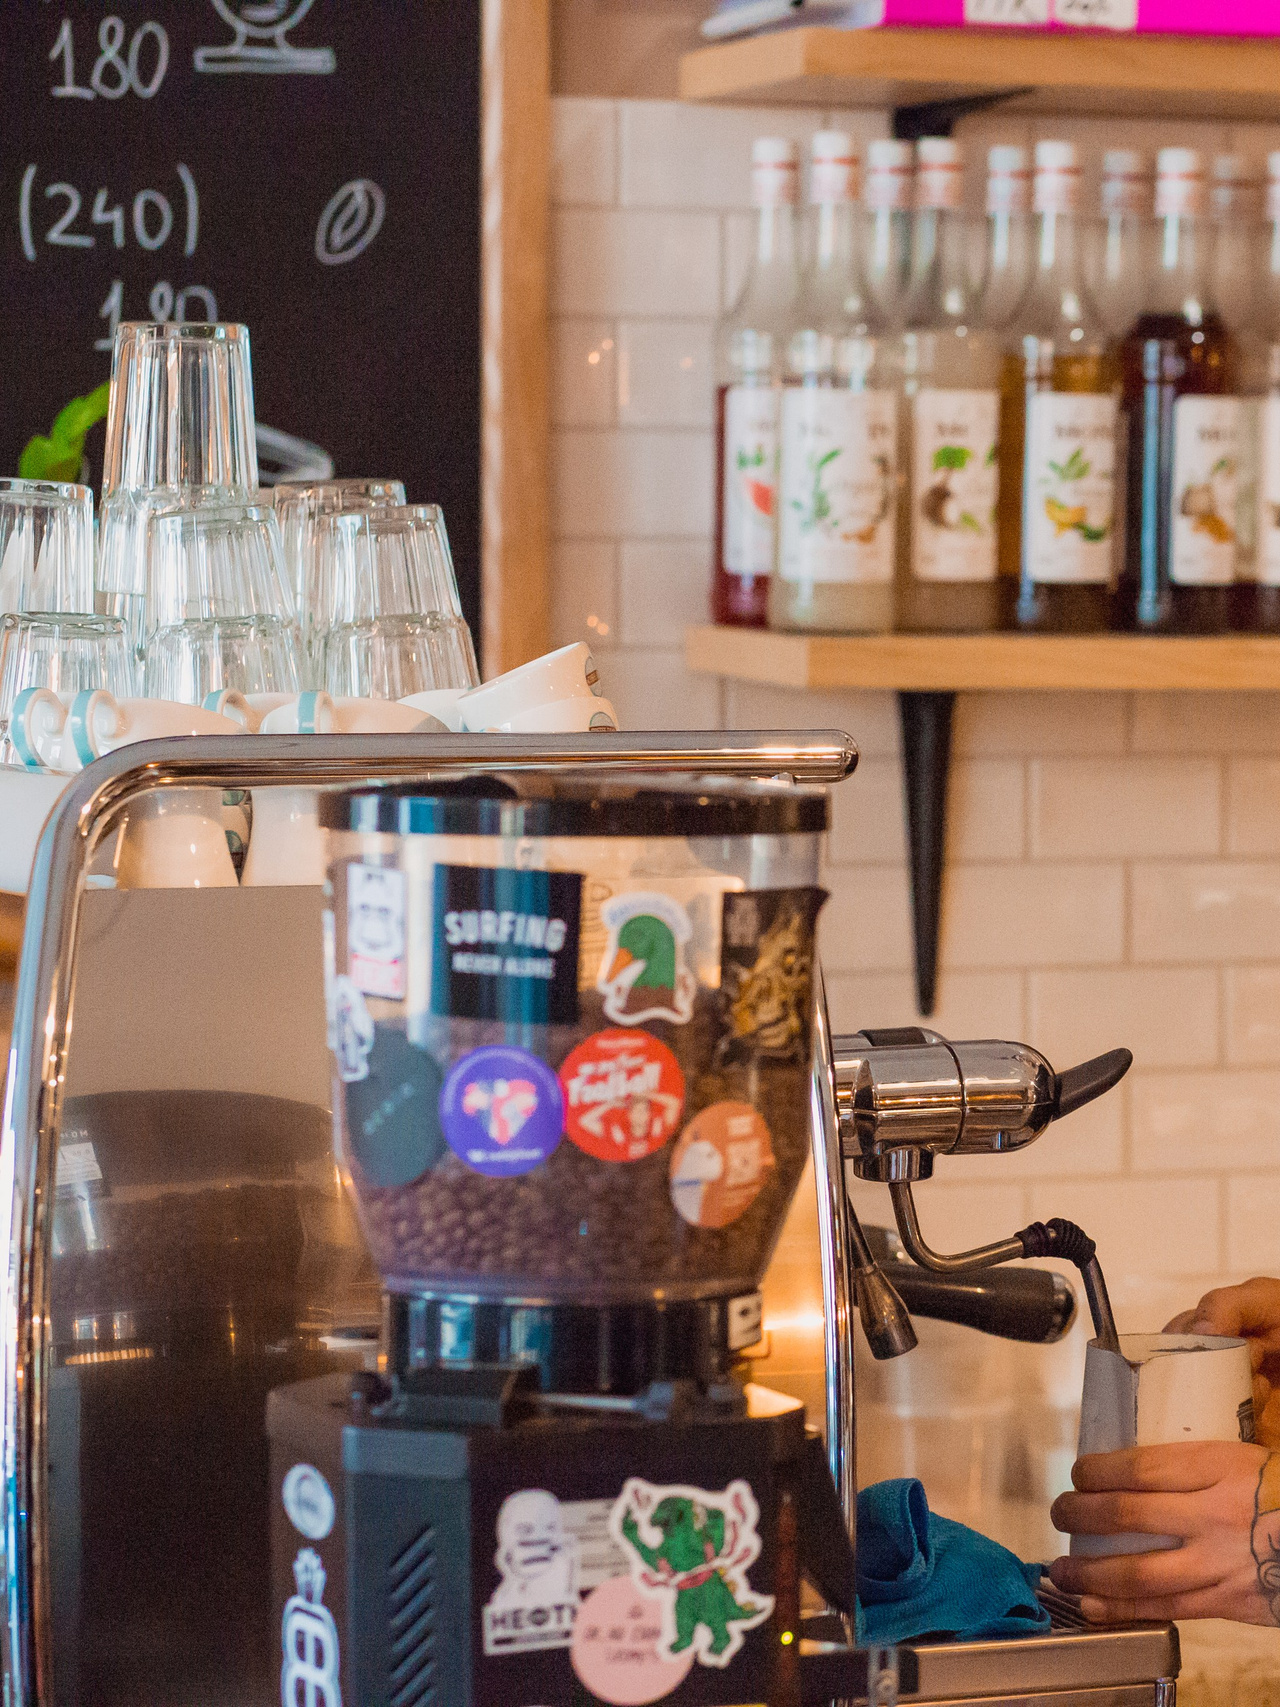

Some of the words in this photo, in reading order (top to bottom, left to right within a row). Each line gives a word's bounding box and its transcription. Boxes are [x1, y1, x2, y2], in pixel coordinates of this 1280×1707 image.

[48, 16, 170, 100] 180
[19, 162, 199, 261] (240)
[443, 909, 568, 953] SURFING
